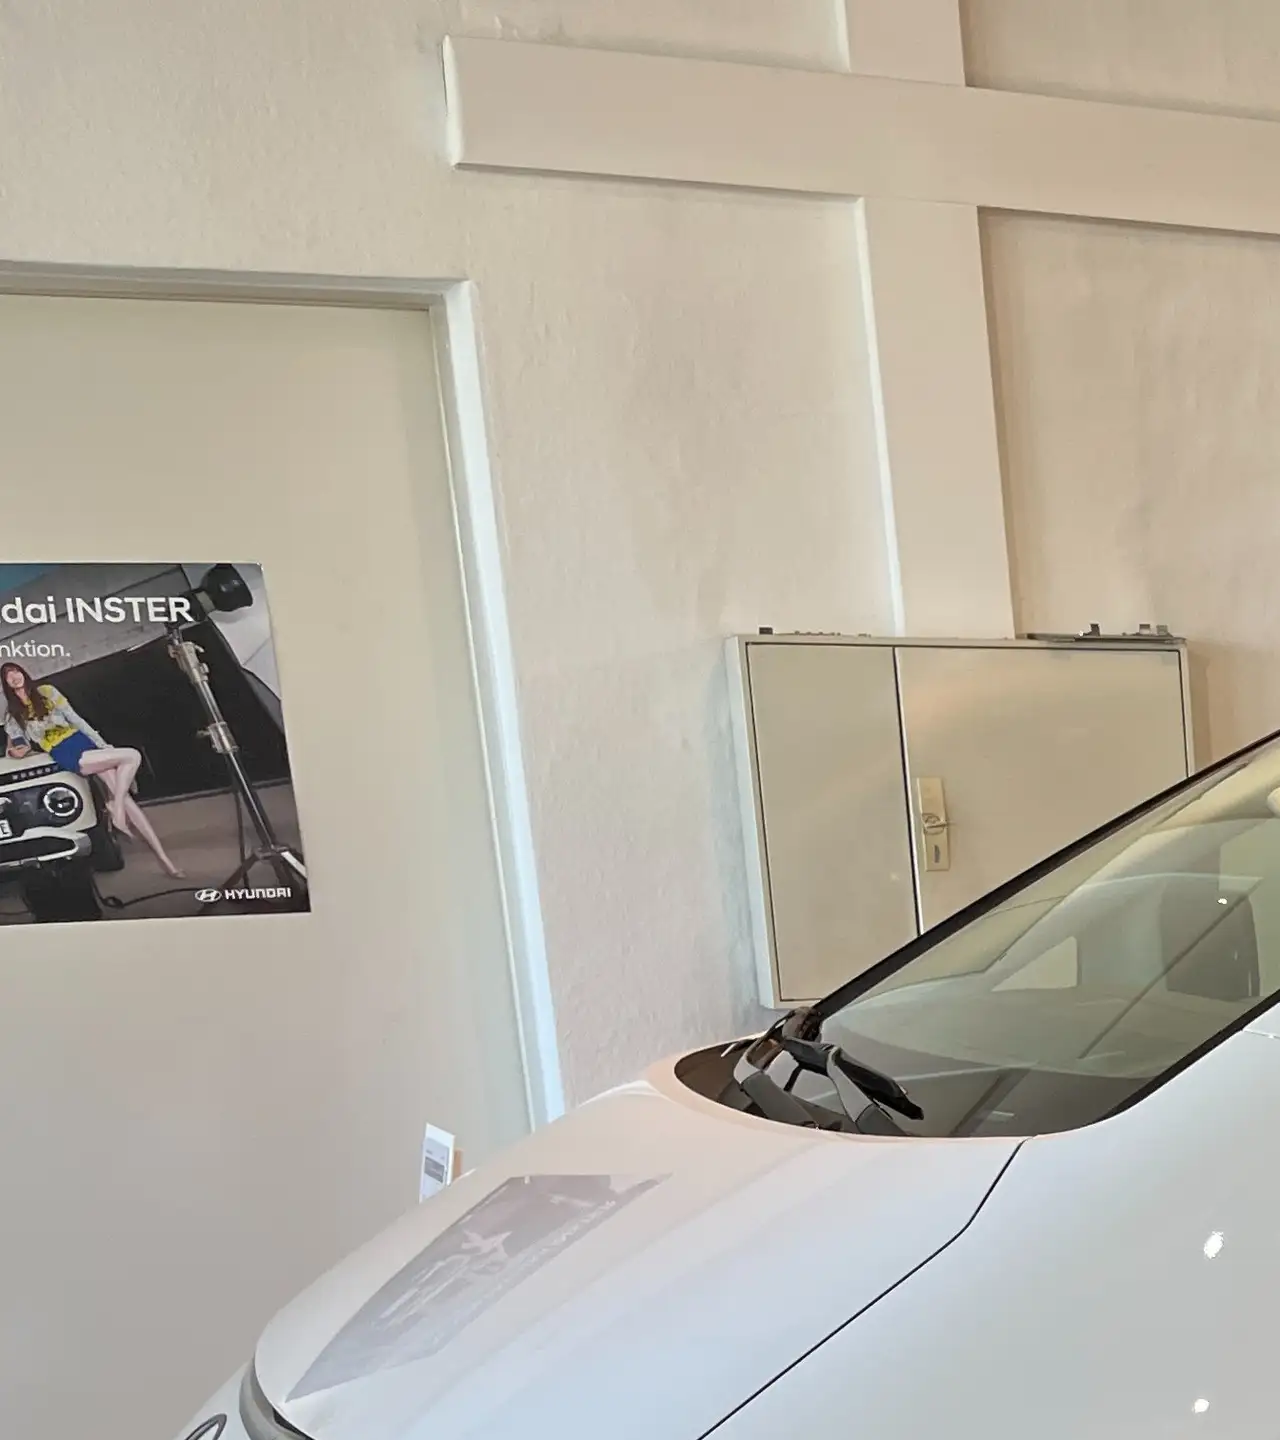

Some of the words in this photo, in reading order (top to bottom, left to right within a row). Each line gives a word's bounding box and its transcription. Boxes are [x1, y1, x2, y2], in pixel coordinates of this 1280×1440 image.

[0, 596, 57, 624] dai
[65, 597, 194, 623] INSTER
[224, 887, 292, 900] HYUNDAI
